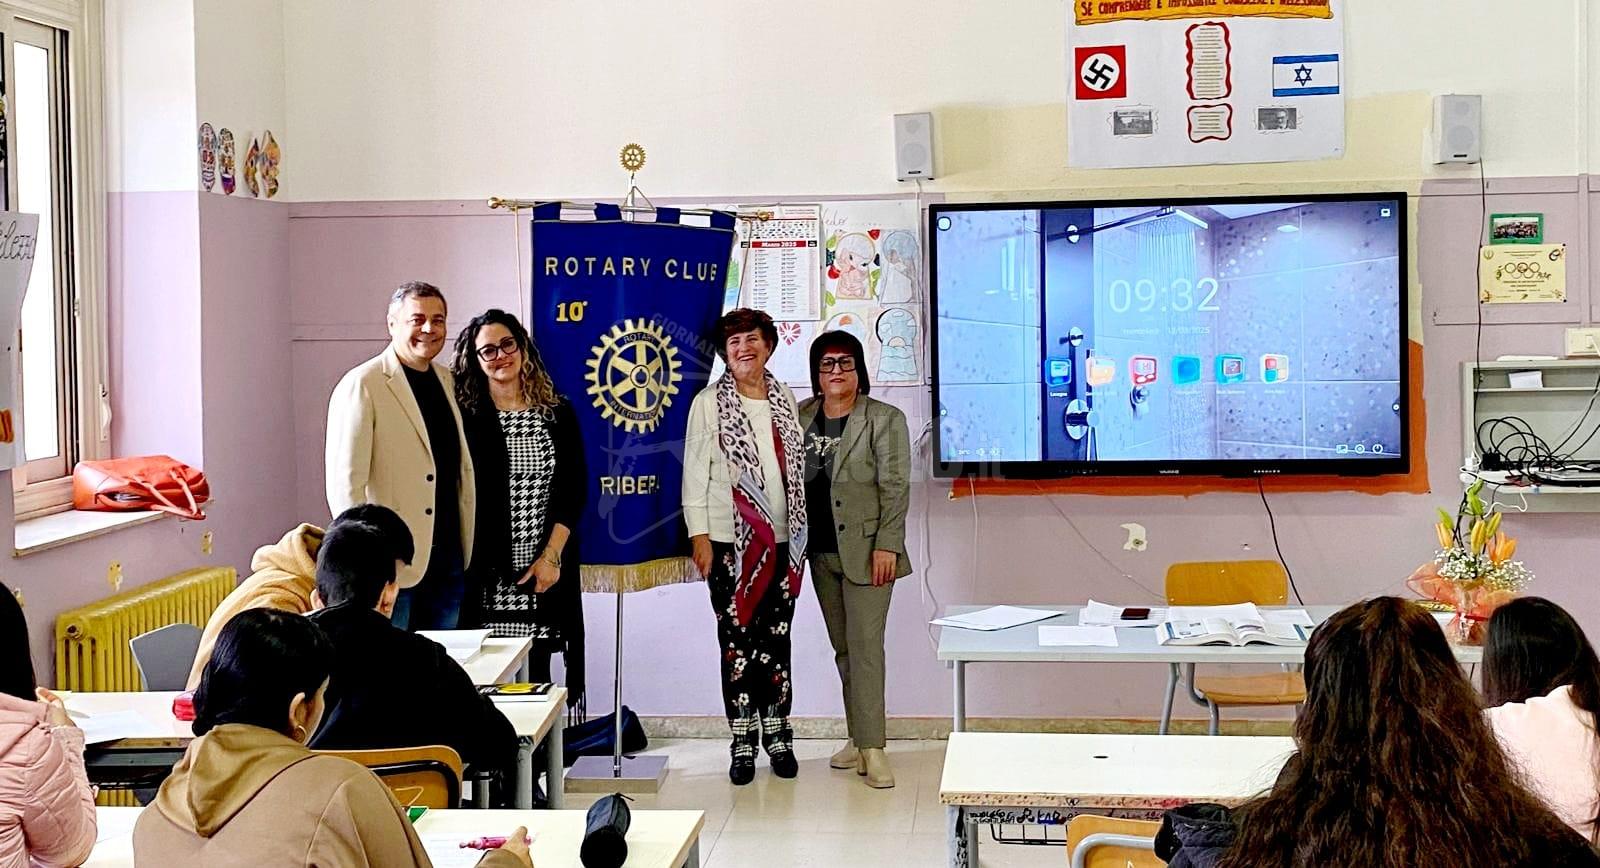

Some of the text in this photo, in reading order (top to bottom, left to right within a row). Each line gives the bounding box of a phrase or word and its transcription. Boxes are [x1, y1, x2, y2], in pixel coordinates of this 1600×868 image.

[545, 257, 718, 282] ROTARY CLUB
[1109, 277, 1220, 313] 09:32
[600, 475, 660, 496] RIBER
